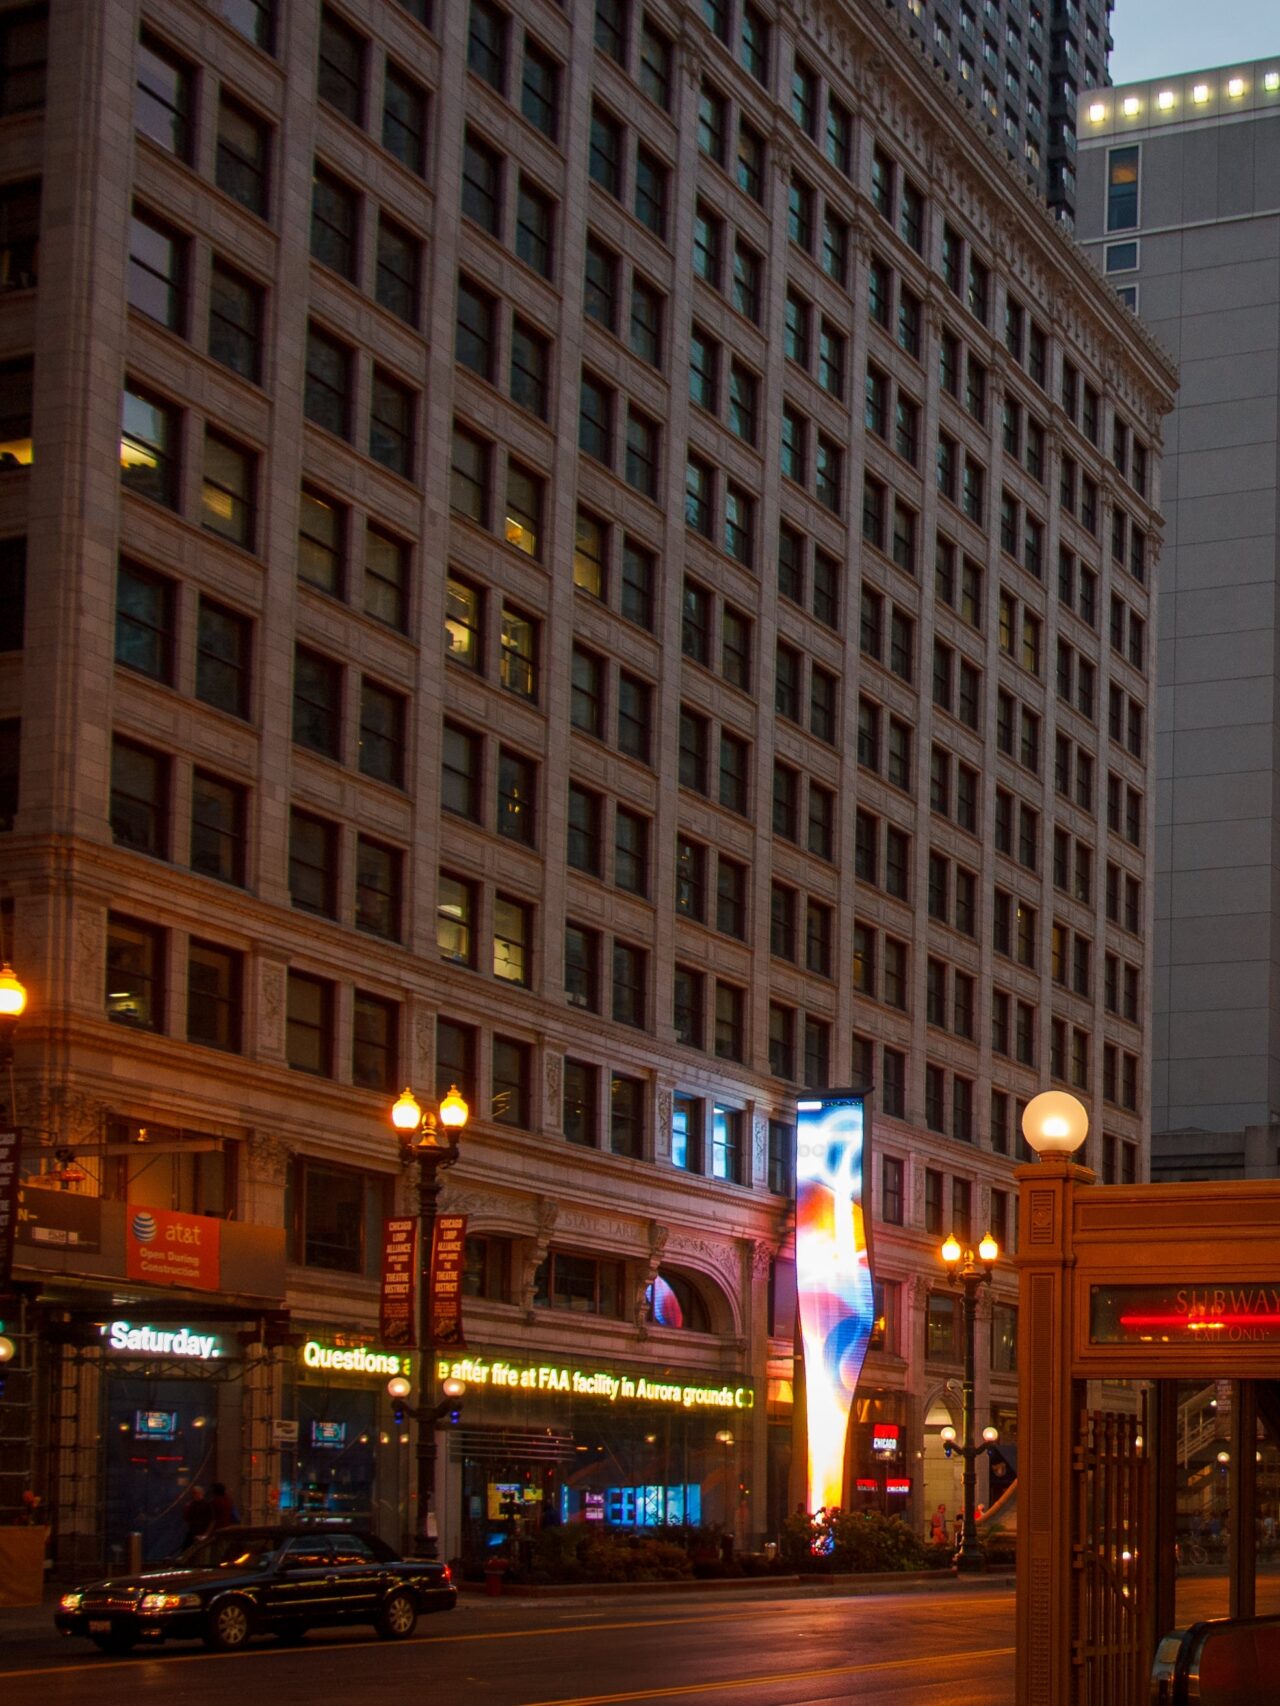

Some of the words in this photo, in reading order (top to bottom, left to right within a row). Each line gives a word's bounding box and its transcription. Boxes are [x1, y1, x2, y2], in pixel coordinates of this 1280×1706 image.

[165, 1222, 202, 1245] at&t
[139, 1247, 165, 1263] Open
[168, 1250, 200, 1267] During
[140, 1259, 200, 1278] Construction
[110, 1321, 221, 1359] Saturday.
[303, 1341, 399, 1375] Questions
[451, 1358, 489, 1384] after
[491, 1362, 518, 1387] fire
[520, 1367, 537, 1388] at
[538, 1367, 570, 1391] FAA
[572, 1371, 620, 1400] facility
[622, 1376, 635, 1398] in
[636, 1378, 682, 1402] Aurora
[682, 1386, 734, 1407] grounds
